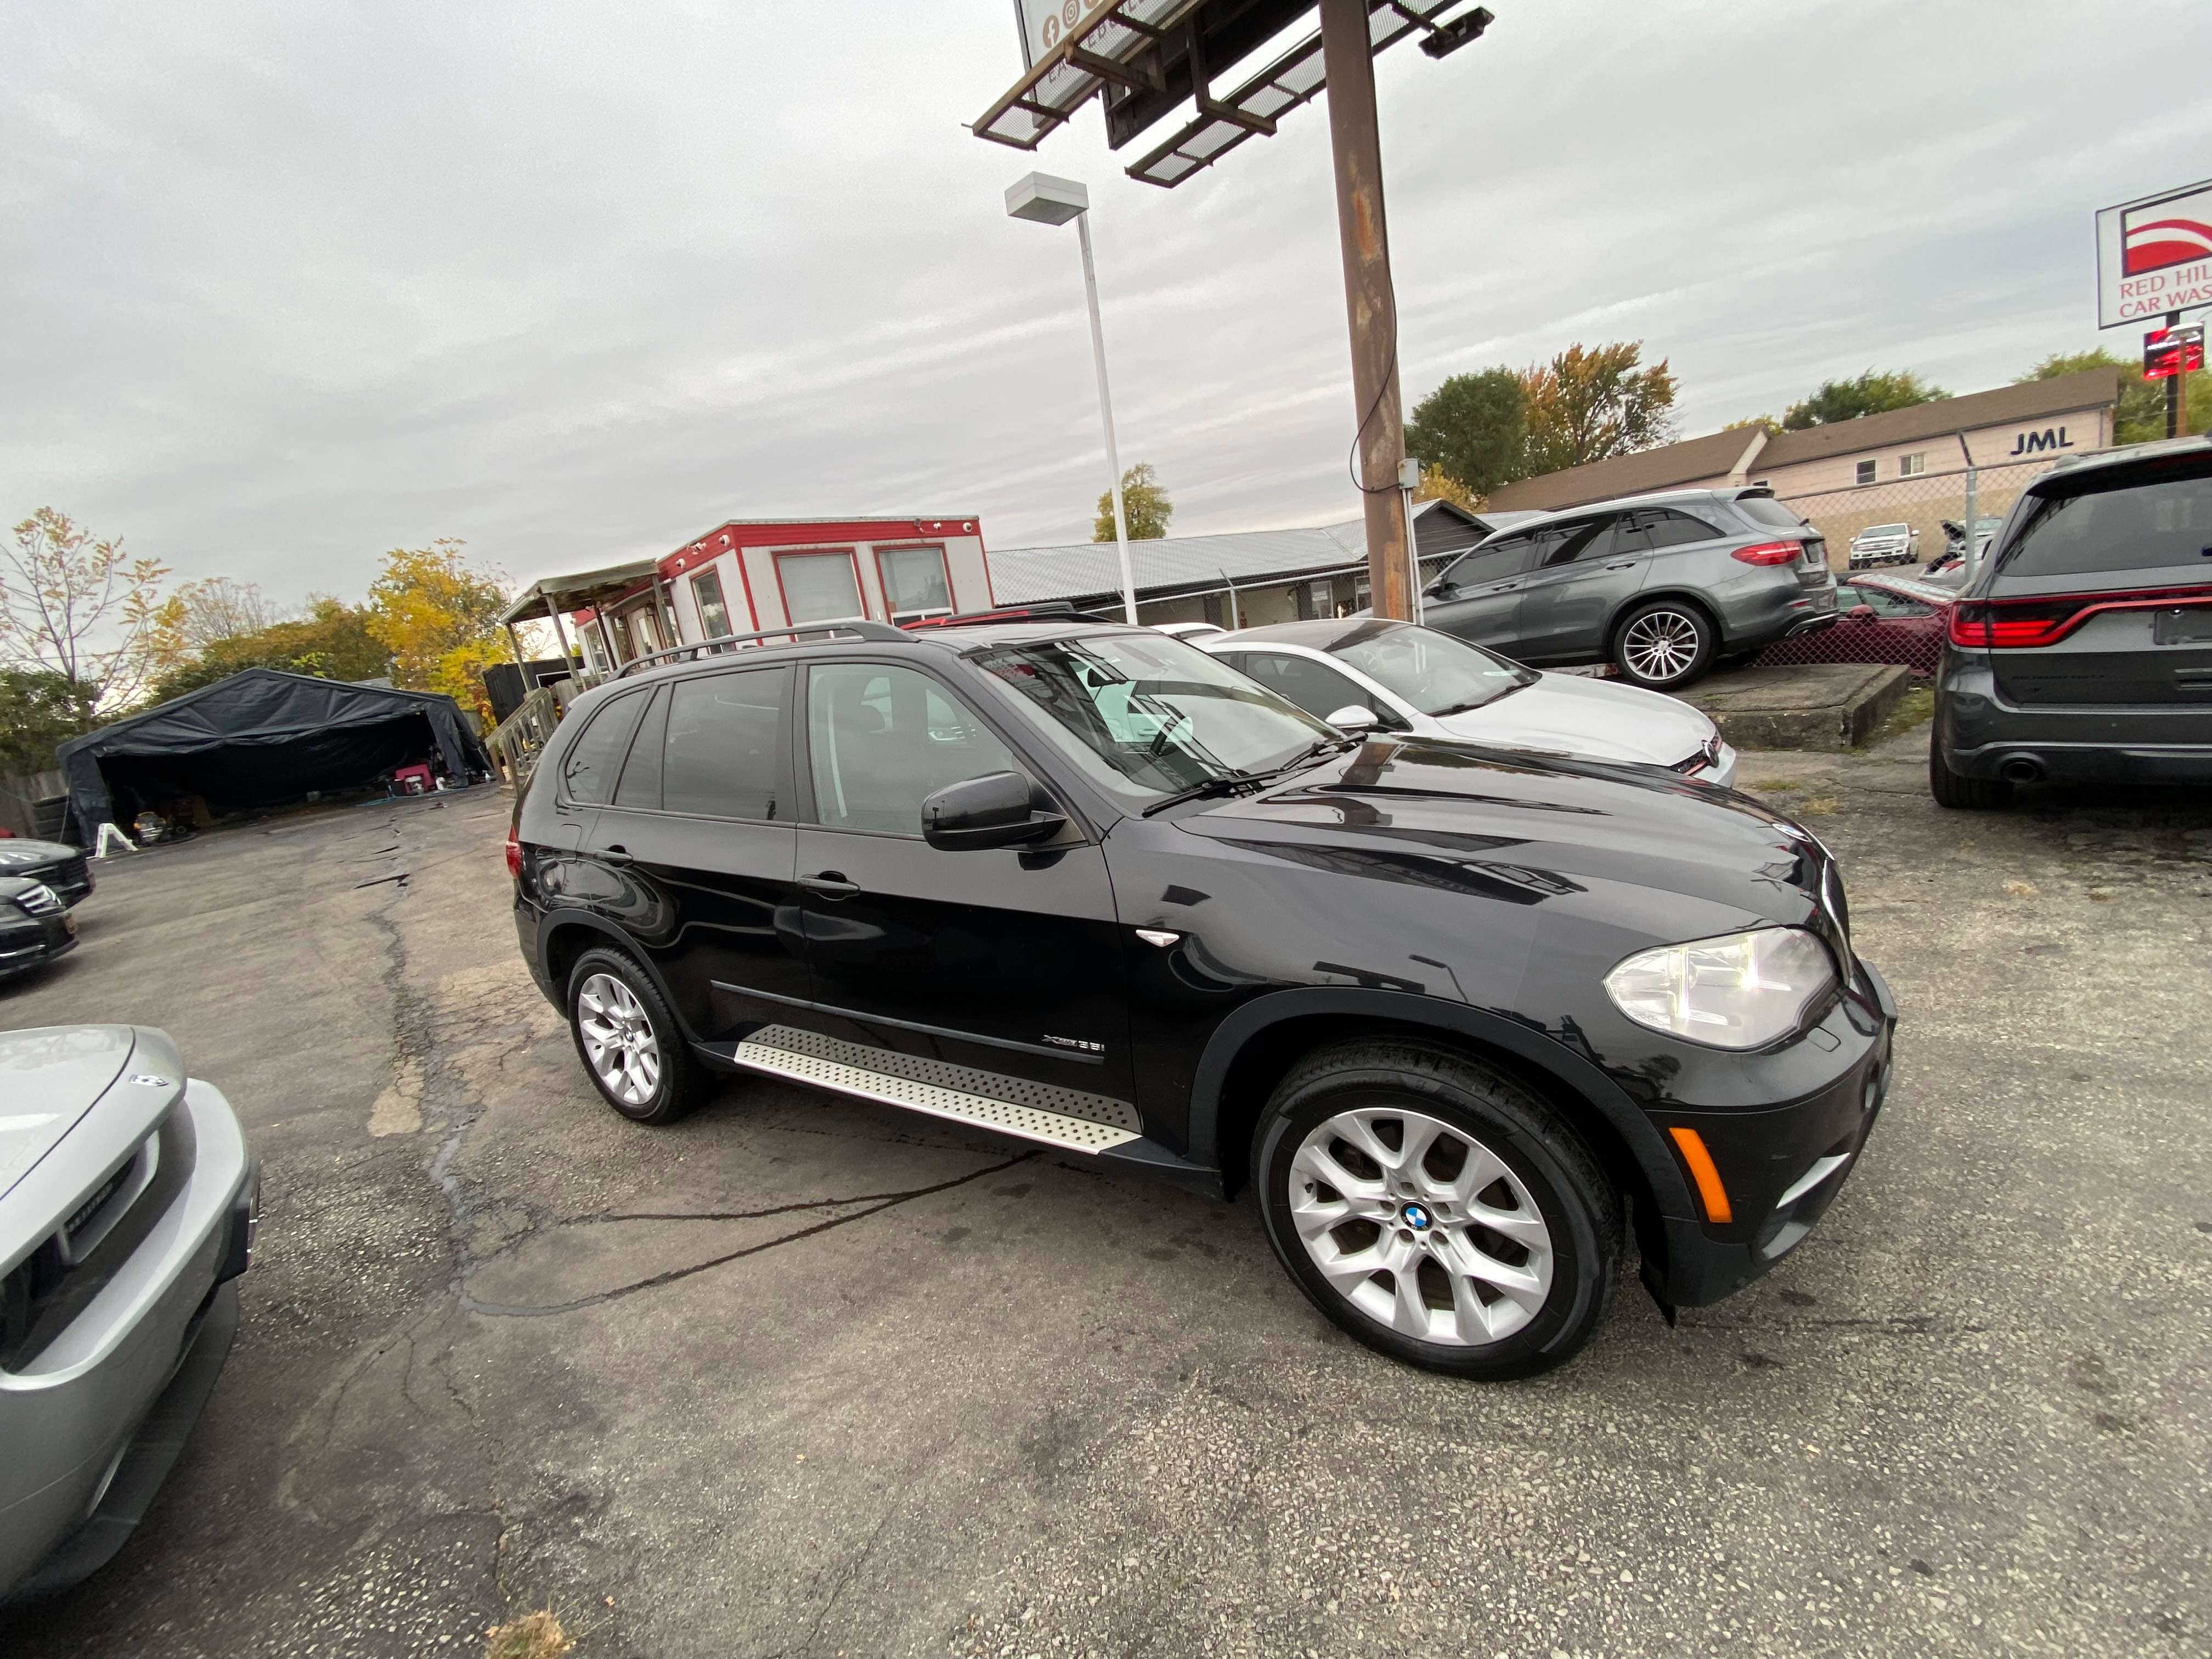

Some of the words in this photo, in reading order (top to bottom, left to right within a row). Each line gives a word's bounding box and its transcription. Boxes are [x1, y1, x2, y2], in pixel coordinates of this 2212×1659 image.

[2119, 275, 2165, 299] RED
[2119, 297, 2160, 318] CAR
[2010, 426, 2074, 455] JML
